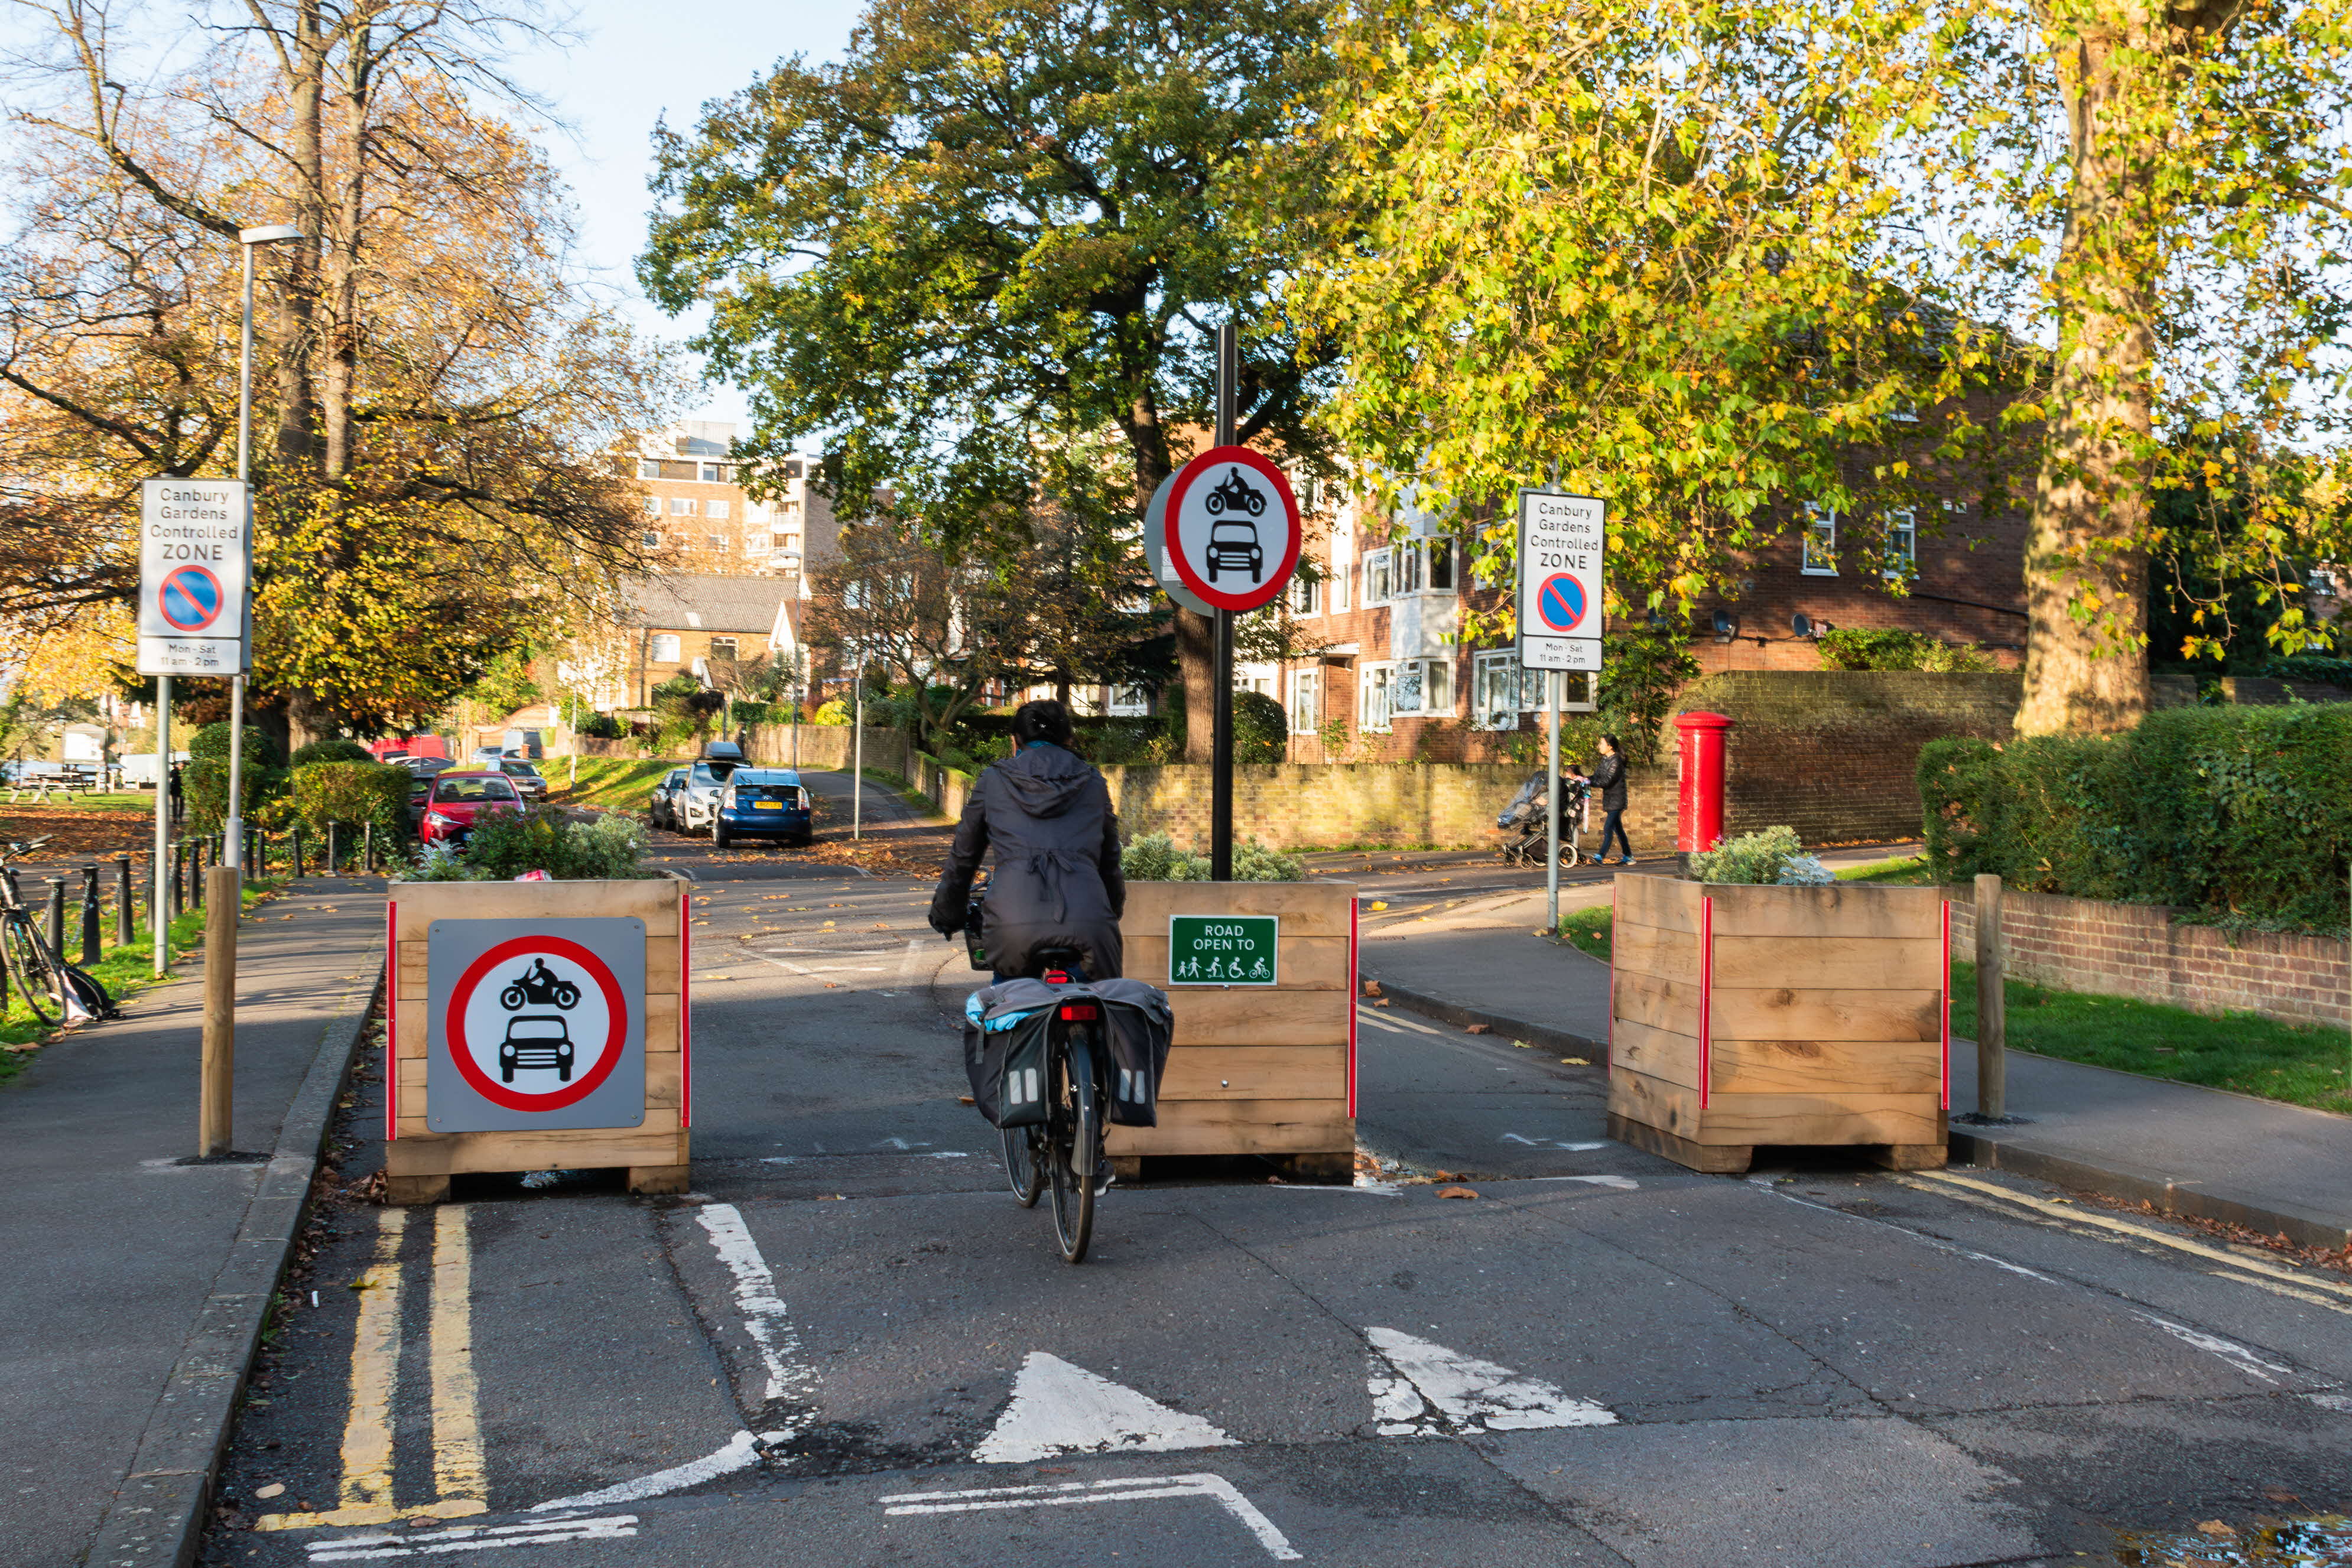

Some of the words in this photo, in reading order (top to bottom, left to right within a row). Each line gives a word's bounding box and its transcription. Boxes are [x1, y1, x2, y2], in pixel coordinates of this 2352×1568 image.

[161, 487, 229, 504] Canbury
[161, 506, 228, 521] Gardens
[1539, 502, 1592, 519] Canbury
[150, 524, 238, 539] Controlled
[1539, 519, 1591, 534] Gardens
[1531, 535, 1599, 551] Controlled
[163, 544, 223, 561] ZONE
[1540, 552, 1587, 570] ZONE
[168, 643, 190, 653] Mon
[199, 645, 216, 654] Sat
[1545, 643, 1563, 652] Mon
[1570, 645, 1583, 653] Sat
[1204, 925, 1244, 936] ROAD
[1193, 938, 1232, 951] OPEN
[1237, 939, 1255, 951] TO
